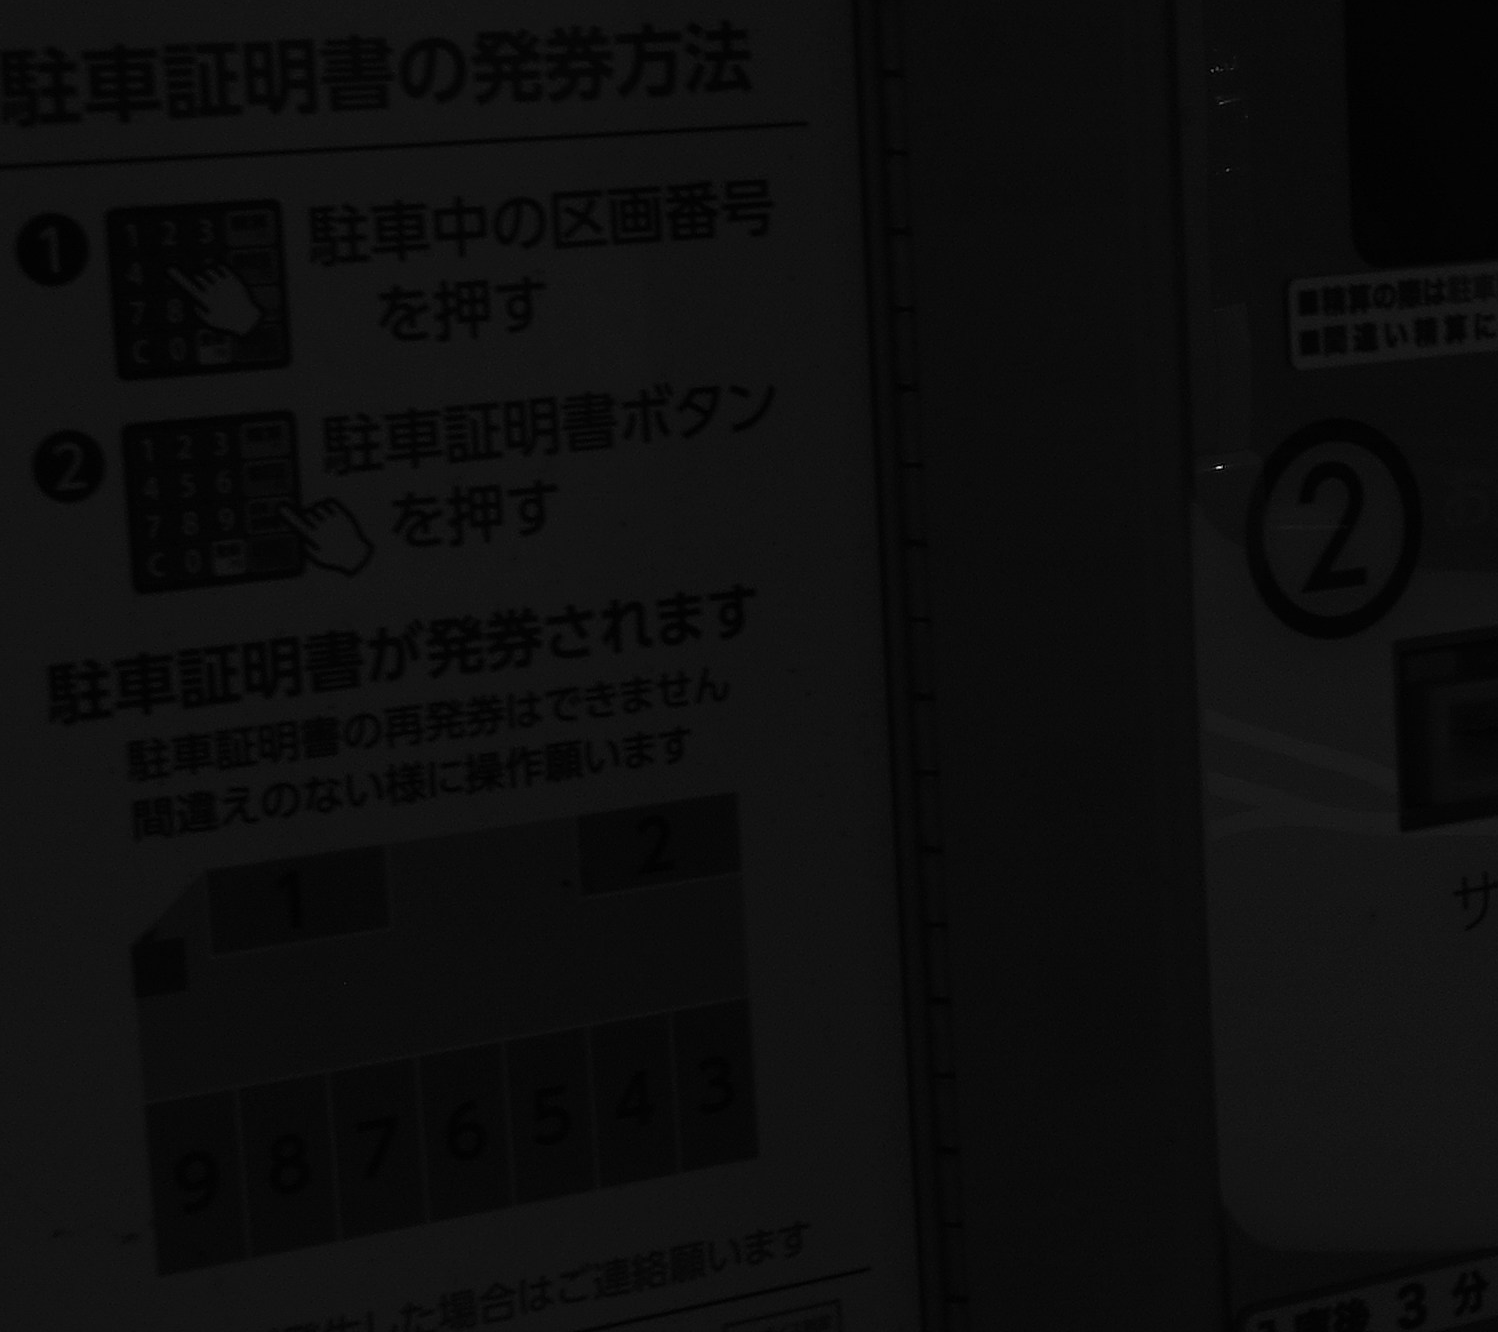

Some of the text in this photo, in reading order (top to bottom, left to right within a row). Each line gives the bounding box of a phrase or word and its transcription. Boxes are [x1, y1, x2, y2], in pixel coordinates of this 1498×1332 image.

[0, 19, 754, 127] 駐車証明書の発券方法
[308, 179, 775, 268] 駐車中の区画番号
[377, 276, 548, 343] を押す
[321, 382, 777, 476] 駐車証明書ボタン
[390, 478, 562, 550] を押す
[46, 582, 759, 726] 駐車証明書が発券されます
[125, 665, 732, 784] 駐車証明書の再発券はできません
[131, 724, 694, 844] 間違えのない様に操作願います
[636, 814, 675, 876] 2
[172, 1054, 738, 1216] 9 8 7 6 5 4 3
[1396, 1283, 1428, 1328] 3
[1451, 1270, 1490, 1314] 分
